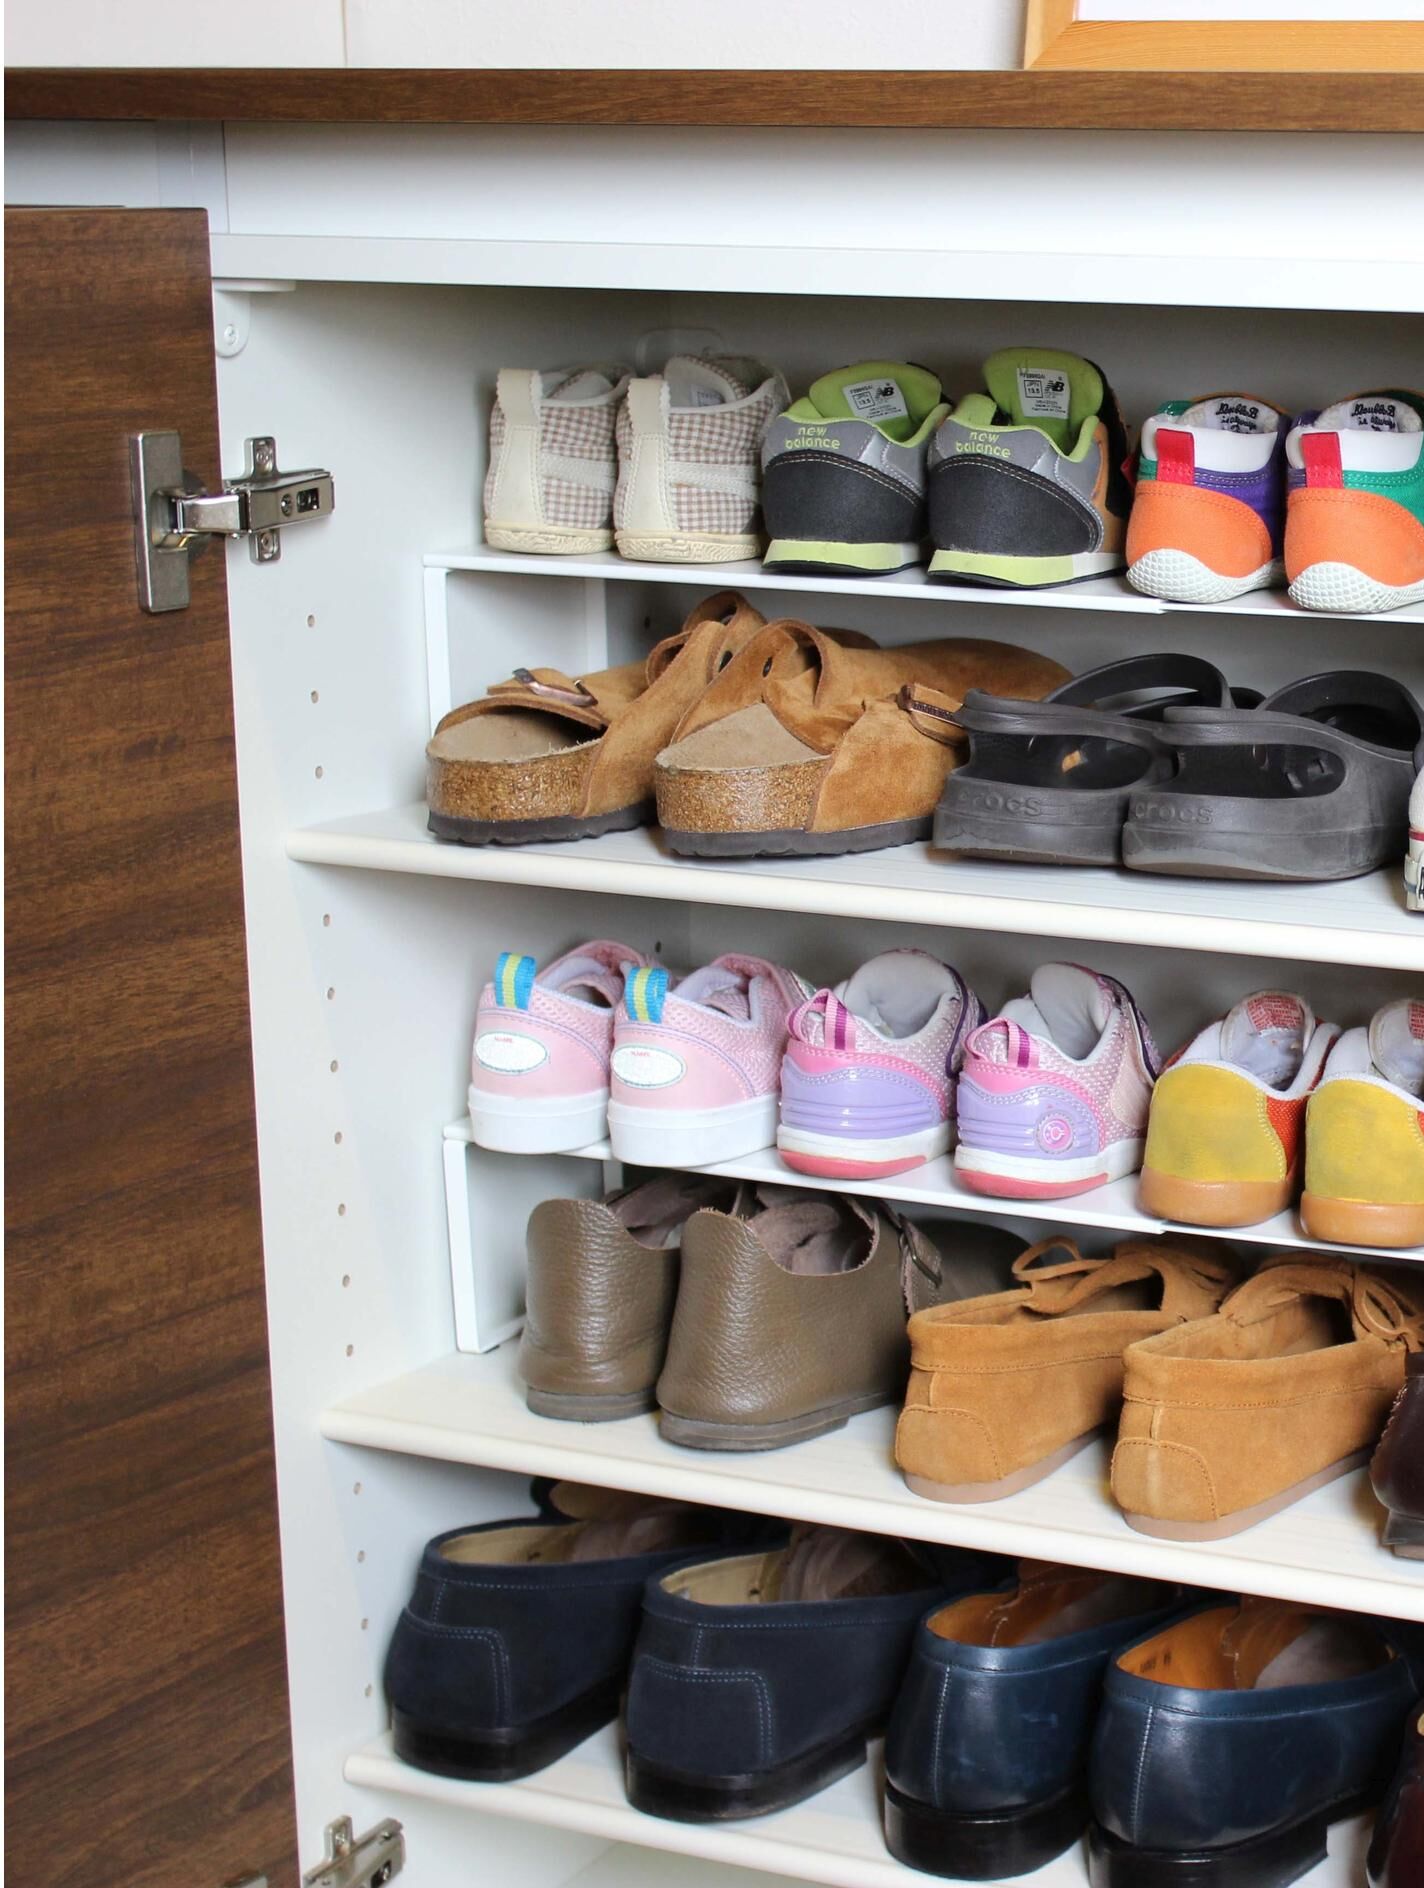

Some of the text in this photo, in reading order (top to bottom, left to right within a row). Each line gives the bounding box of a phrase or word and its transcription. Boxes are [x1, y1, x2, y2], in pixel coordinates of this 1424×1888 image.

[798, 426, 828, 437] new
[970, 431, 1000, 444] new
[785, 437, 841, 450] balance
[955, 441, 1011, 458] balance
[959, 791, 1042, 816] crocs
[1135, 802, 1216, 825] crocs
